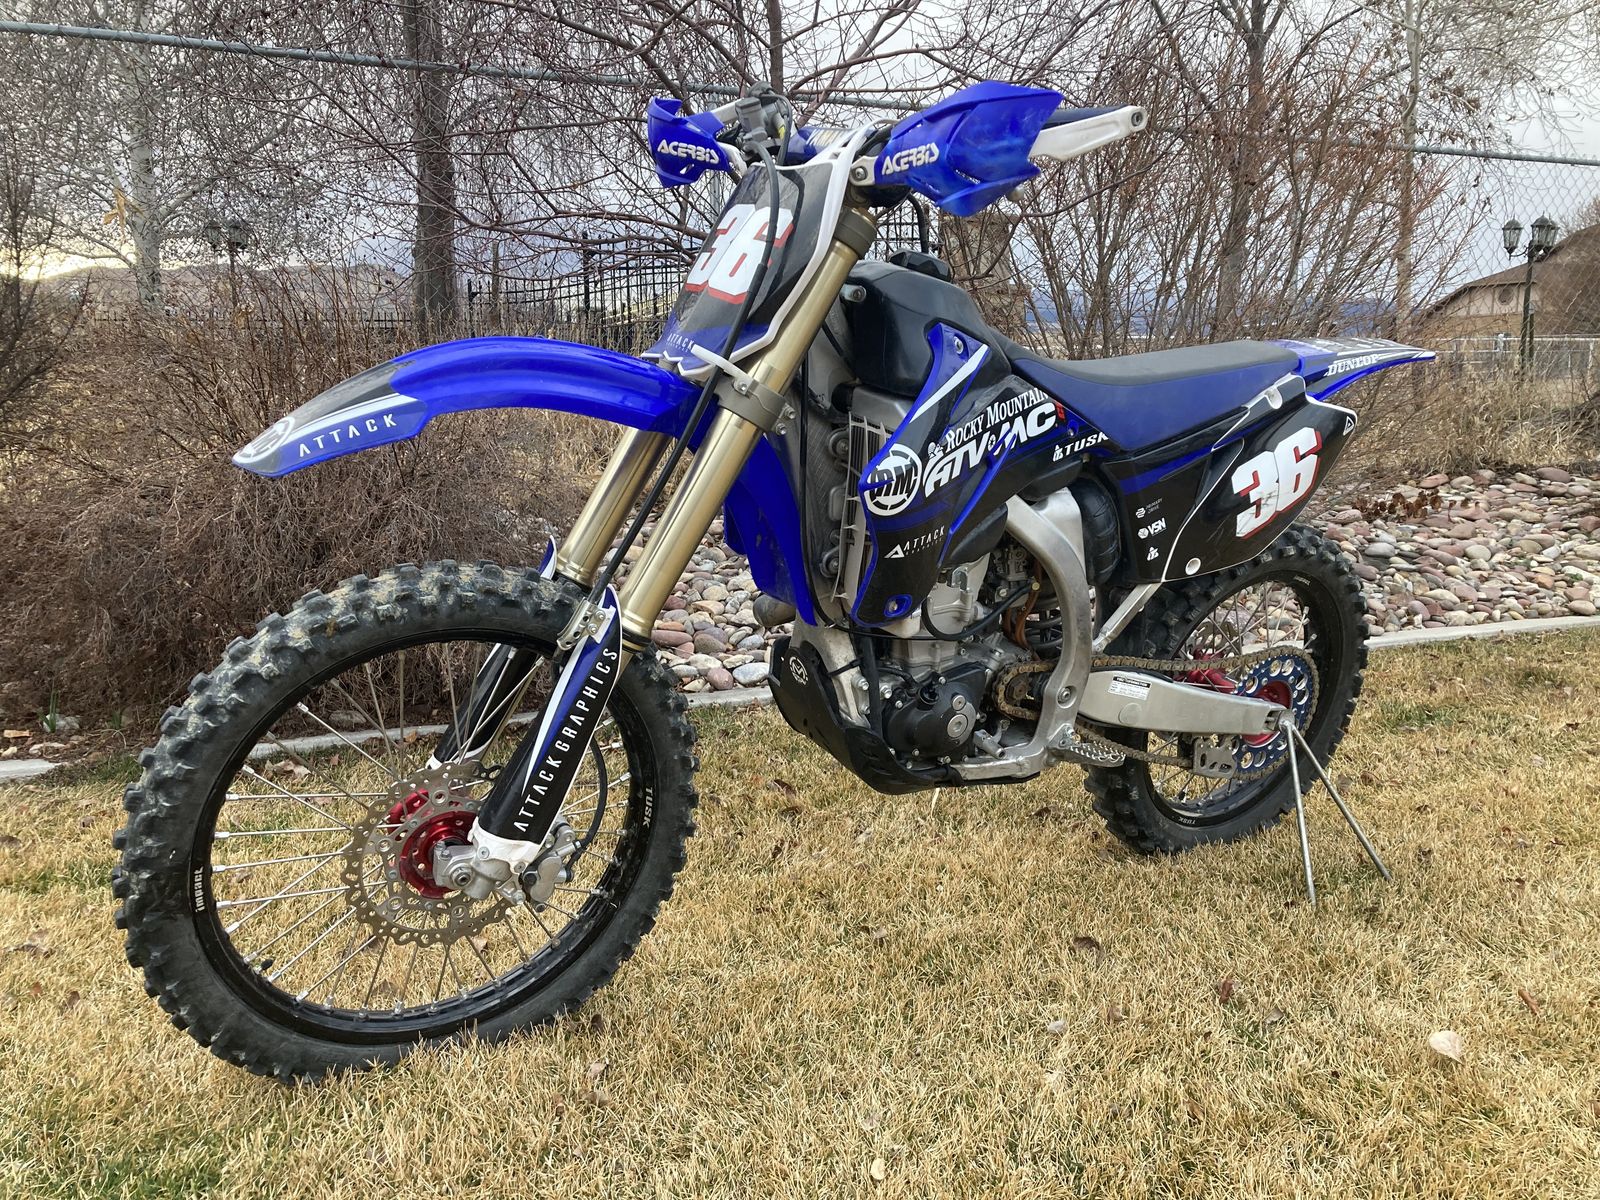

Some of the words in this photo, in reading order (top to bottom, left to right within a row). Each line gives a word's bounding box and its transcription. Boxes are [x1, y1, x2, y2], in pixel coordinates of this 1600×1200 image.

[657, 139, 720, 165] ACERBIS
[881, 142, 940, 175] ACERBIS
[684, 203, 795, 305] 36
[666, 332, 695, 350] ATTACK
[1325, 353, 1380, 377] DUNLOP
[299, 413, 397, 458] ATTACK
[945, 413, 985, 453] ROCKY
[1230, 426, 1323, 540] 36
[903, 525, 945, 551] ATTACK
[1147, 517, 1167, 535] VSN
[513, 753, 562, 833] ATTACK
[554, 646, 618, 752] GRAPHICS
[642, 786, 654, 829] TUSK
[194, 866, 205, 912] impact
